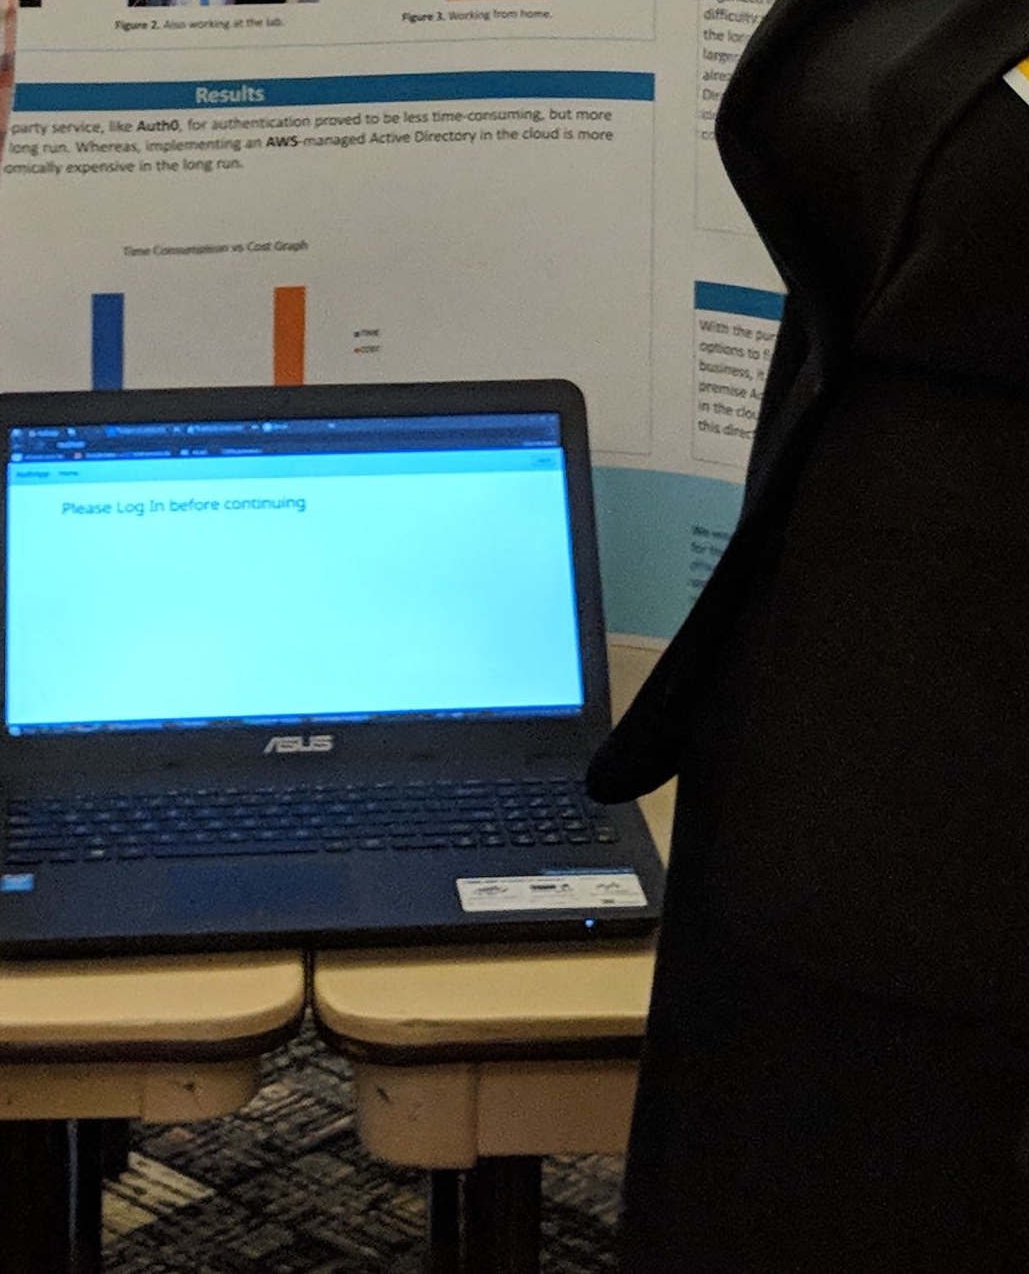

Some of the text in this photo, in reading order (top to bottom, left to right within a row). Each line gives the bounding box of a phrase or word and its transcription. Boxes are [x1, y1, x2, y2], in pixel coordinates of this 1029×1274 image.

[402, 9, 552, 23] Figure 3. Working from home.
[195, 86, 265, 103] Results
[52, 120, 104, 135] service,
[109, 119, 132, 132] like
[188, 117, 207, 130] for
[211, 115, 311, 130] authentication
[314, 113, 362, 130] proved
[365, 114, 380, 126] to
[383, 112, 400, 126] be
[404, 111, 429, 125] less
[549, 108, 572, 121] but
[576, 111, 612, 121] more
[247, 241, 271, 252] Cost
[274, 240, 308, 253] Graph
[62, 497, 306, 516] Please Log In before continuing
[264, 735, 334, 753] ASUS
